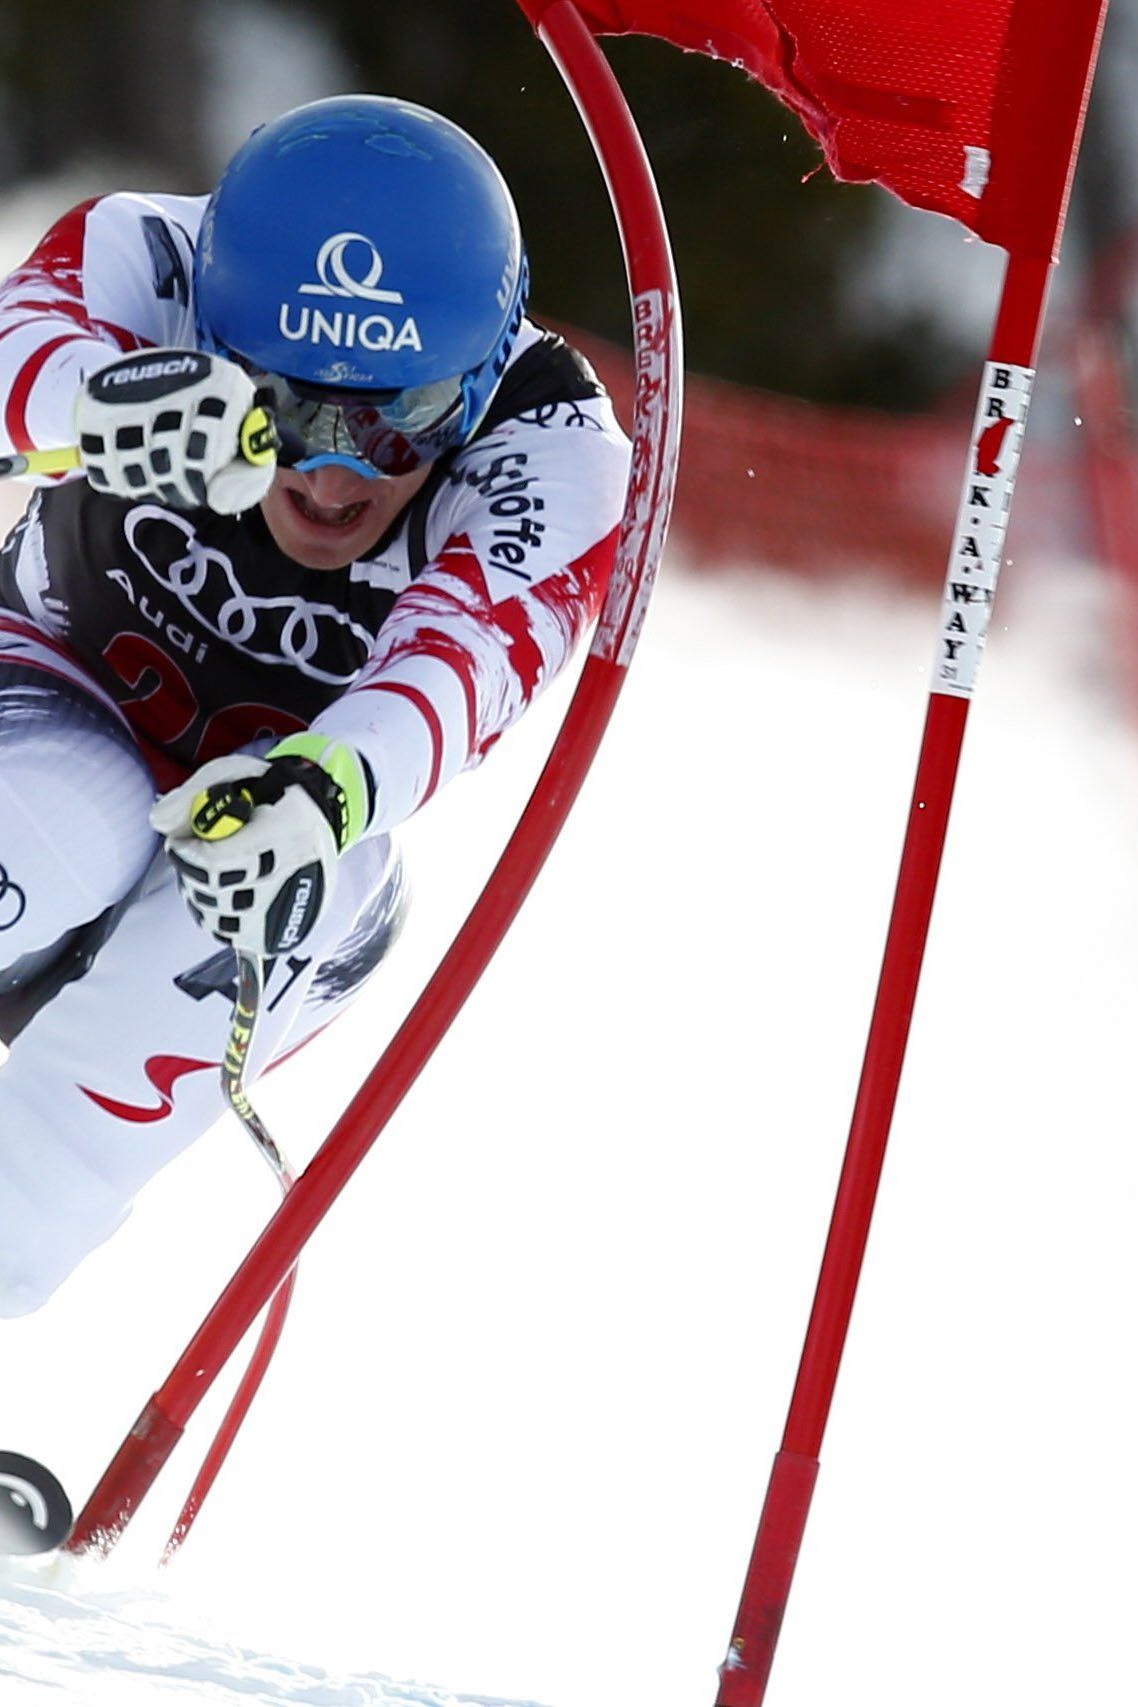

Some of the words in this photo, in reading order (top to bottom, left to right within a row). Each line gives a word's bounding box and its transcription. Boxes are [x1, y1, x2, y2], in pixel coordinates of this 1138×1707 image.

[279, 303, 423, 352] UNIQA
[102, 356, 199, 388] reusch
[105, 568, 209, 663] Audi
[277, 877, 313, 950] reusch
